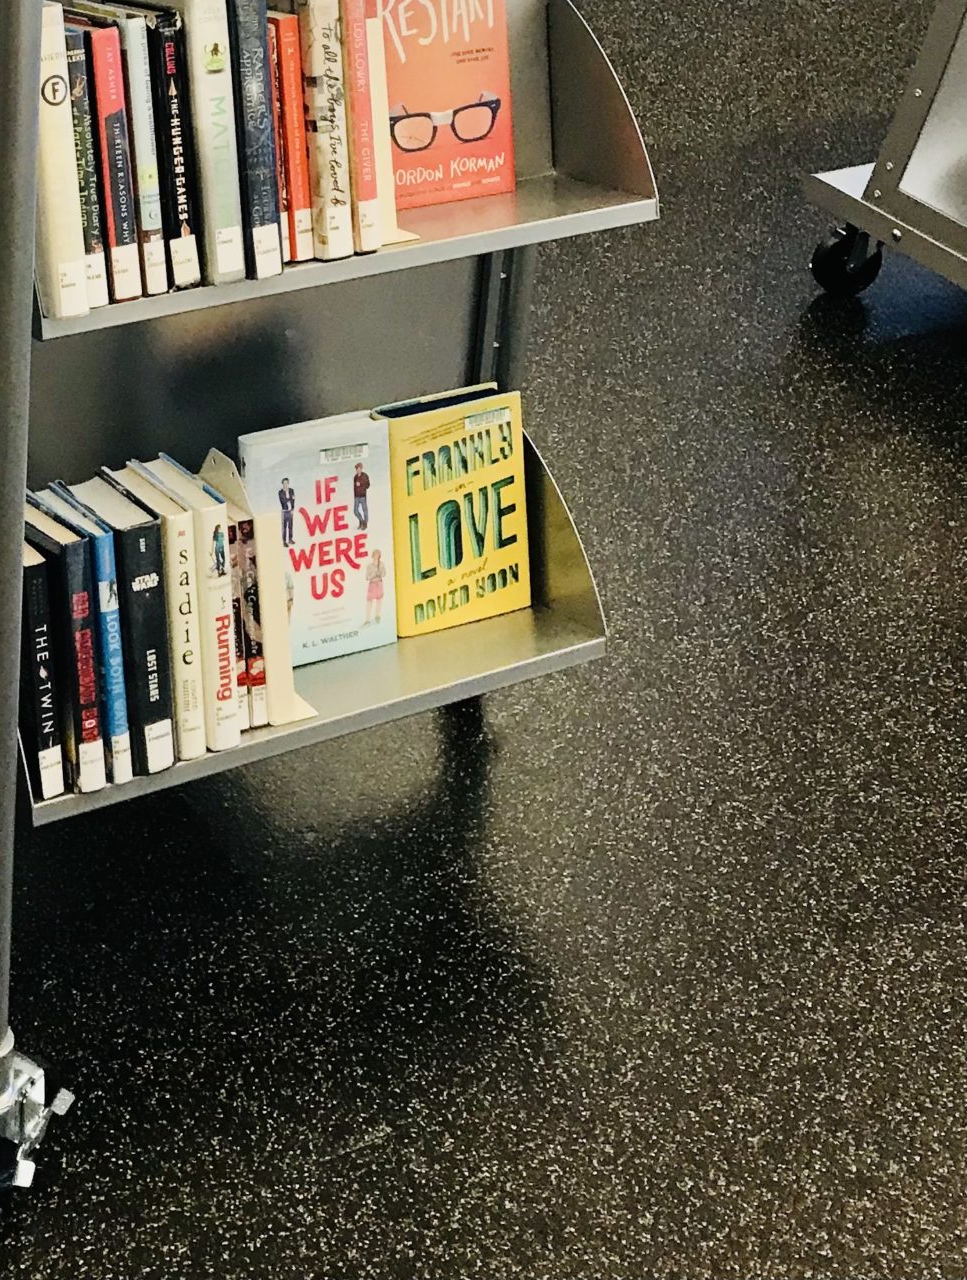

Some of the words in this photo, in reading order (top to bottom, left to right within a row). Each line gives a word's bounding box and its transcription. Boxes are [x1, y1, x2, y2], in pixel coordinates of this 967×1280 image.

[353, 22, 365, 49] LOIS
[105, 46, 116, 67] JAY
[164, 41, 176, 75] COLLINS
[321, 44, 338, 63] all
[51, 81, 60, 98] F
[107, 69, 118, 101] ASHER
[355, 52, 367, 94] LOWRY
[170, 98, 179, 116] THE
[320, 96, 342, 131] boys
[82, 114, 98, 175] Absolutely
[171, 117, 184, 174] HUNGER
[329, 133, 343, 157] I've
[360, 121, 370, 144] THE
[73, 126, 86, 188] Part-Time
[361, 147, 373, 182] GIVER
[394, 165, 444, 186] ORDON
[450, 152, 506, 179] KORMAN
[88, 177, 98, 203] True
[328, 159, 346, 194] loved
[175, 176, 189, 221] GAMES
[89, 205, 102, 236] Diary
[122, 221, 131, 244] WHY
[405, 421, 514, 497] FRANKLY
[315, 475, 339, 505] IF
[299, 505, 349, 537] WE
[408, 475, 518, 585] LOVE
[288, 532, 369, 572] WERE
[461, 557, 488, 580] novel
[311, 569, 346, 601] US
[414, 583, 471, 625] DAVID
[475, 562, 520, 599] YOON
[178, 548, 195, 666] sadie
[34, 623, 50, 663] THE
[106, 614, 121, 652] LOOK
[320, 630, 360, 646] WALTHER
[146, 648, 157, 672] LOST
[215, 614, 235, 702] Running
[108, 658, 122, 694] BOTH
[148, 673, 160, 703] STARS
[37, 681, 55, 734] TWIN
